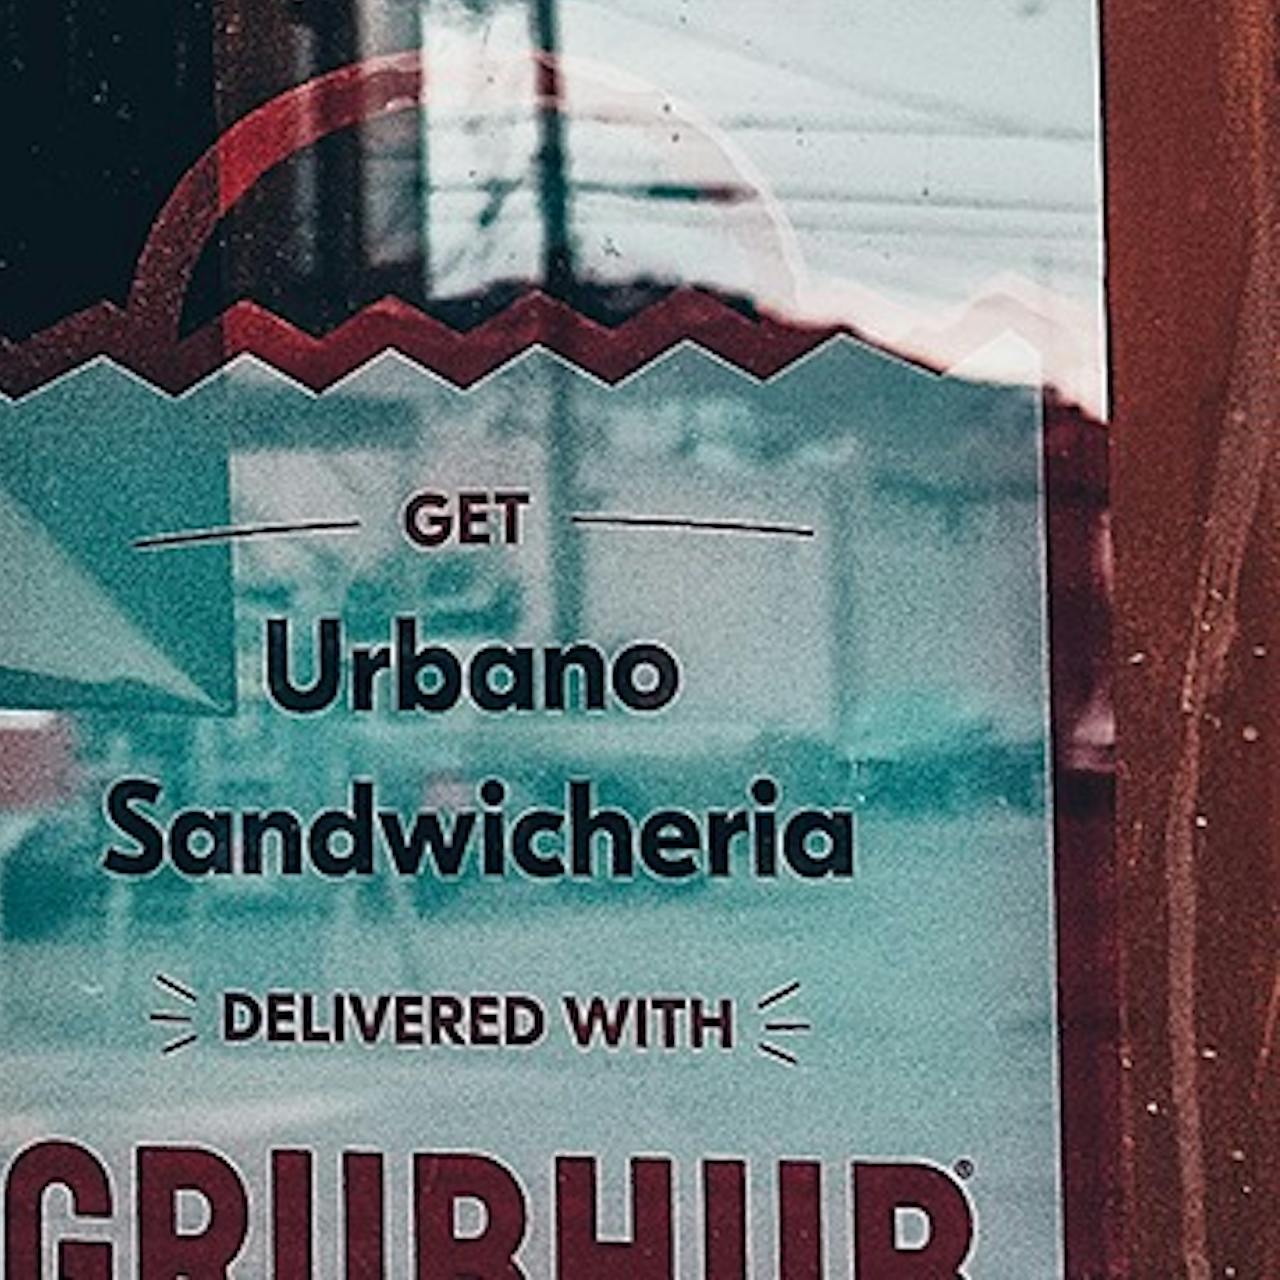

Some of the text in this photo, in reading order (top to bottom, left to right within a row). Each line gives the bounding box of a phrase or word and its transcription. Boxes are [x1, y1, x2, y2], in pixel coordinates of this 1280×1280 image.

[402, 492, 531, 548] GET
[264, 618, 681, 714] Urbano
[102, 779, 856, 881] Sandwicheria
[221, 992, 735, 1051] DELIVERED WITH
[4, 1140, 976, 1280] GRUBHUB
